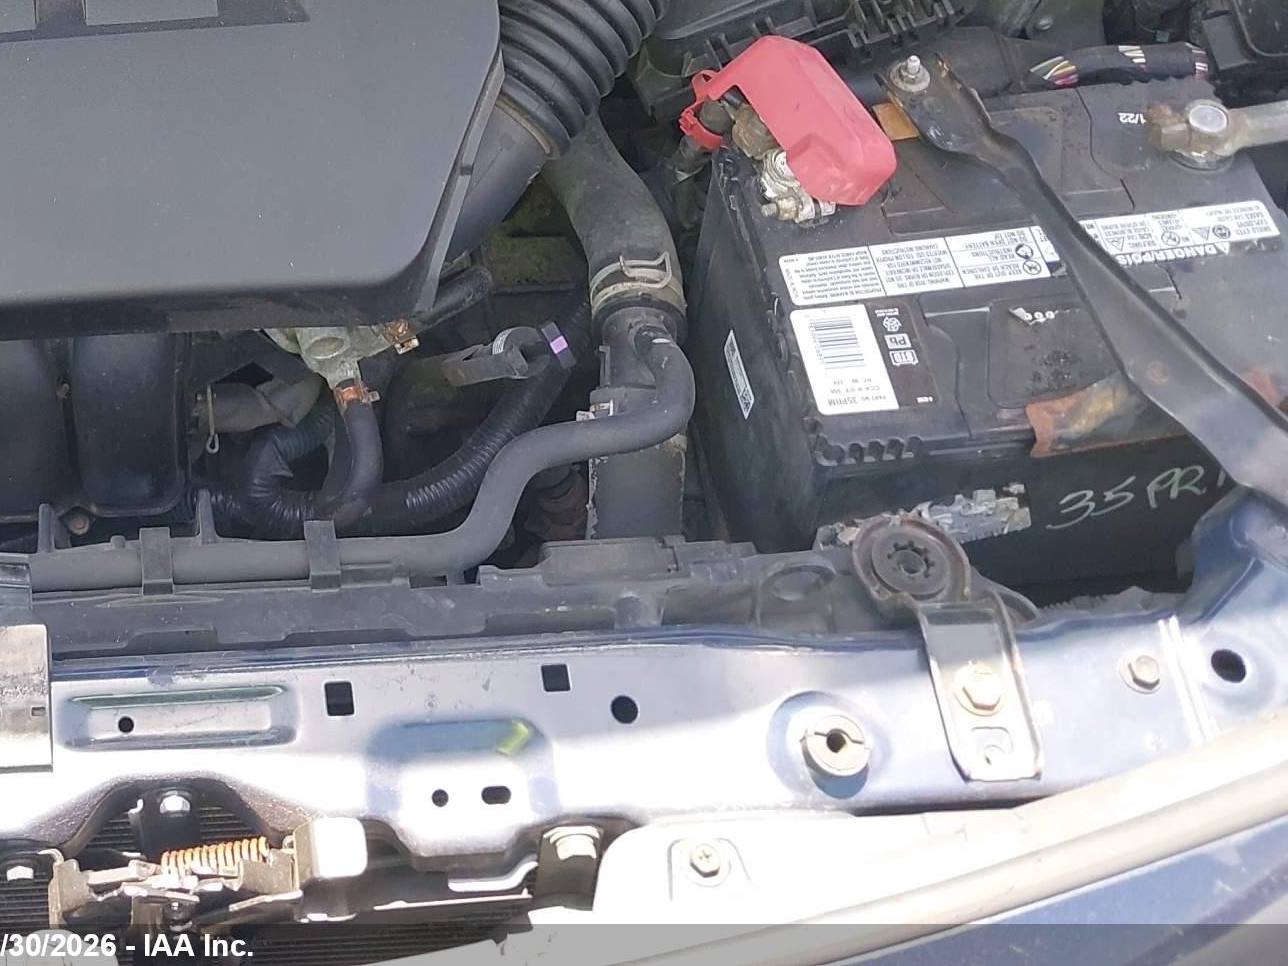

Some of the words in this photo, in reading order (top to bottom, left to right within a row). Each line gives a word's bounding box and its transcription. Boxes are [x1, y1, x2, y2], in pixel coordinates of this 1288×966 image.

[1115, 245, 1217, 266] DANGER/POIS
[889, 336, 907, 348] Pb
[1046, 465, 1226, 531] 35PR
